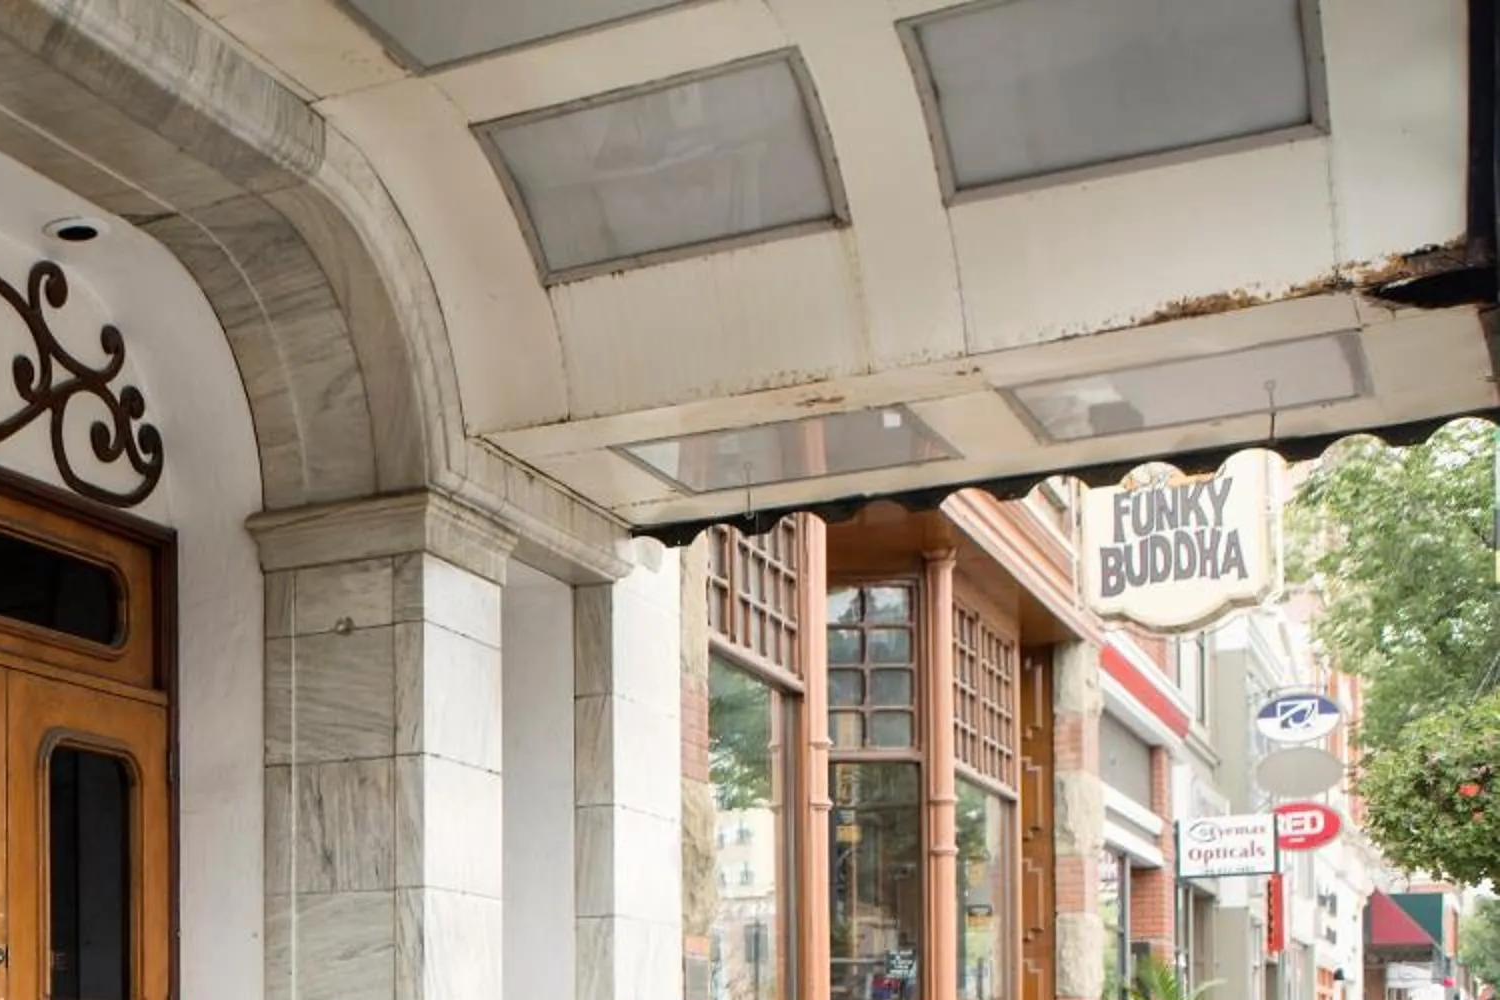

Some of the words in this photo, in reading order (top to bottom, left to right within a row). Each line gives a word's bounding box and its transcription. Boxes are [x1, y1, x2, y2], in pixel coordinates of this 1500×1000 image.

[1113, 476, 1233, 544] FUNKY
[1099, 528, 1249, 598] BUDDHA
[1187, 839, 1267, 865] Opticals
